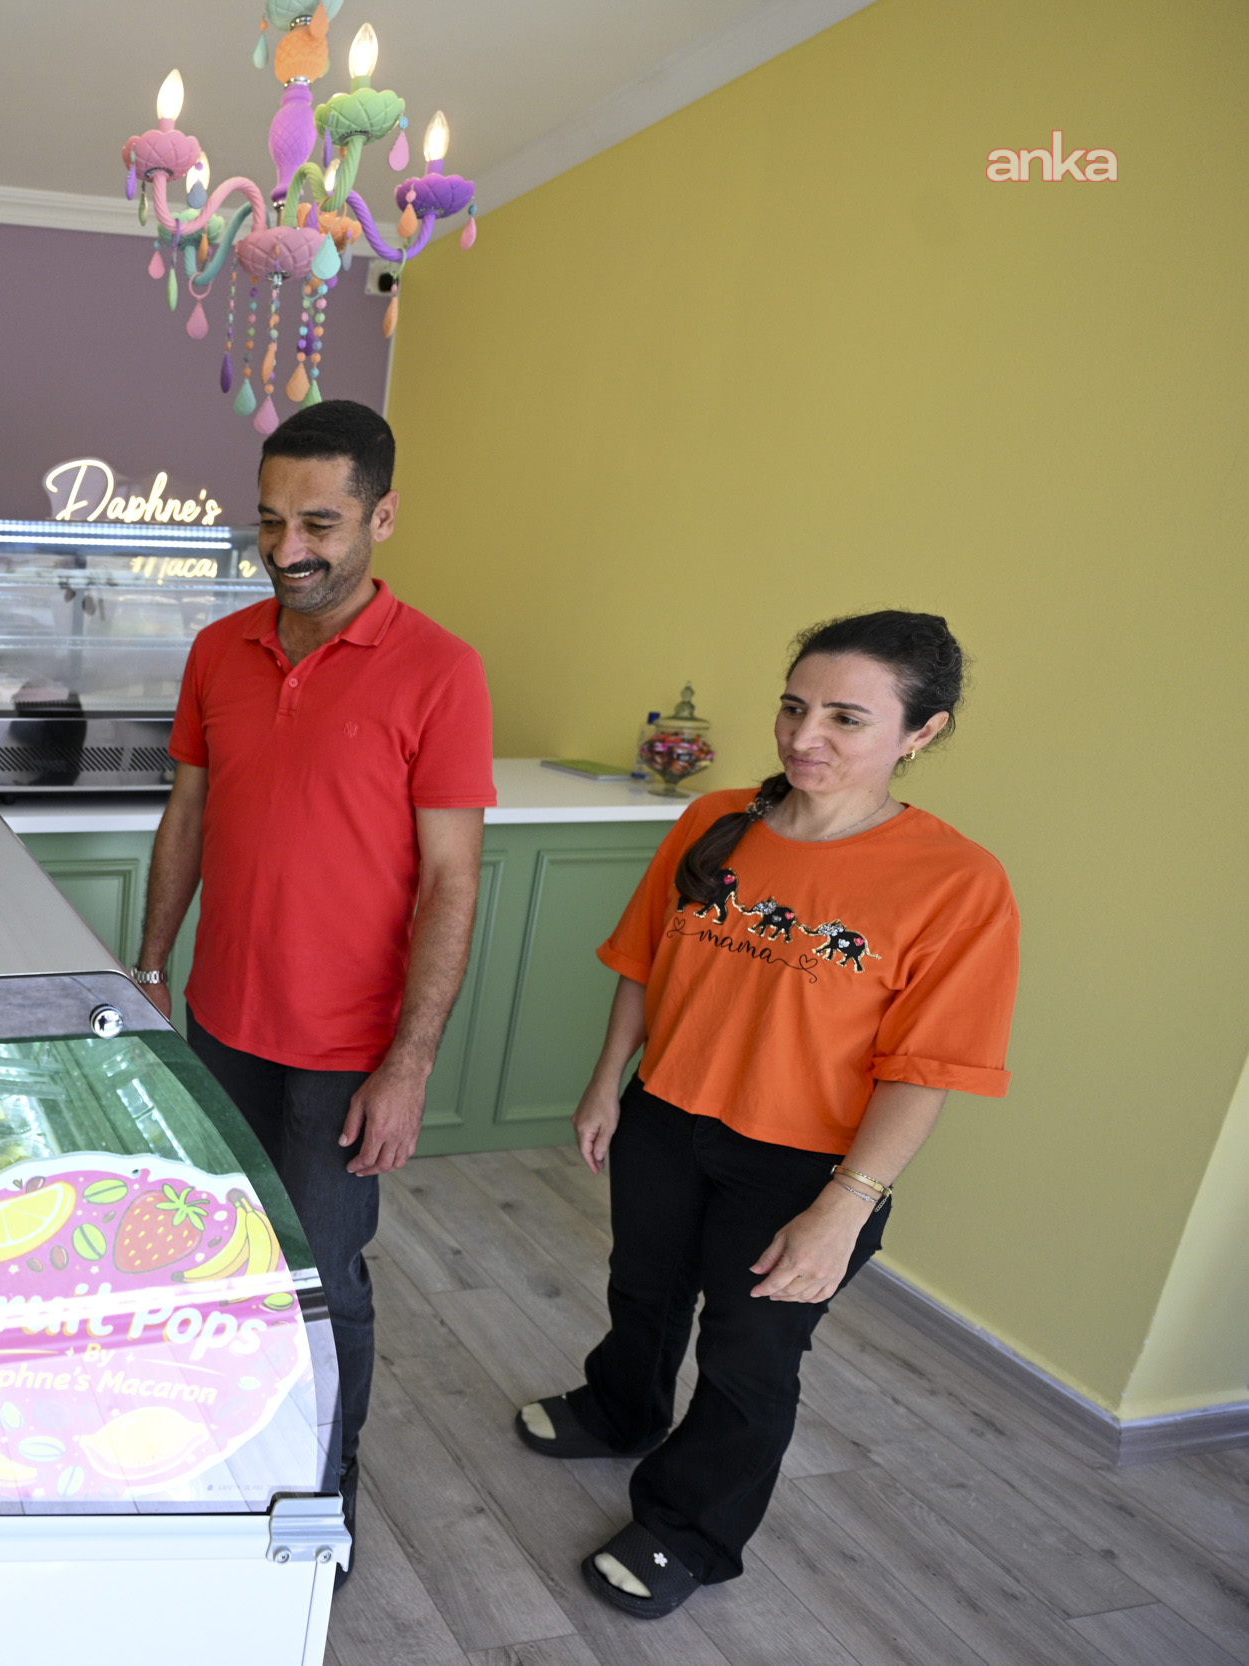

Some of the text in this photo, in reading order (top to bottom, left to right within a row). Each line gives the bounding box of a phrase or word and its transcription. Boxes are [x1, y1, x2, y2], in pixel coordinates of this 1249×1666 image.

[45, 458, 223, 525] Daphne's
[127, 1286, 267, 1361] Pops
[82, 1343, 116, 1368] By
[96, 1369, 218, 1405] Macaron
